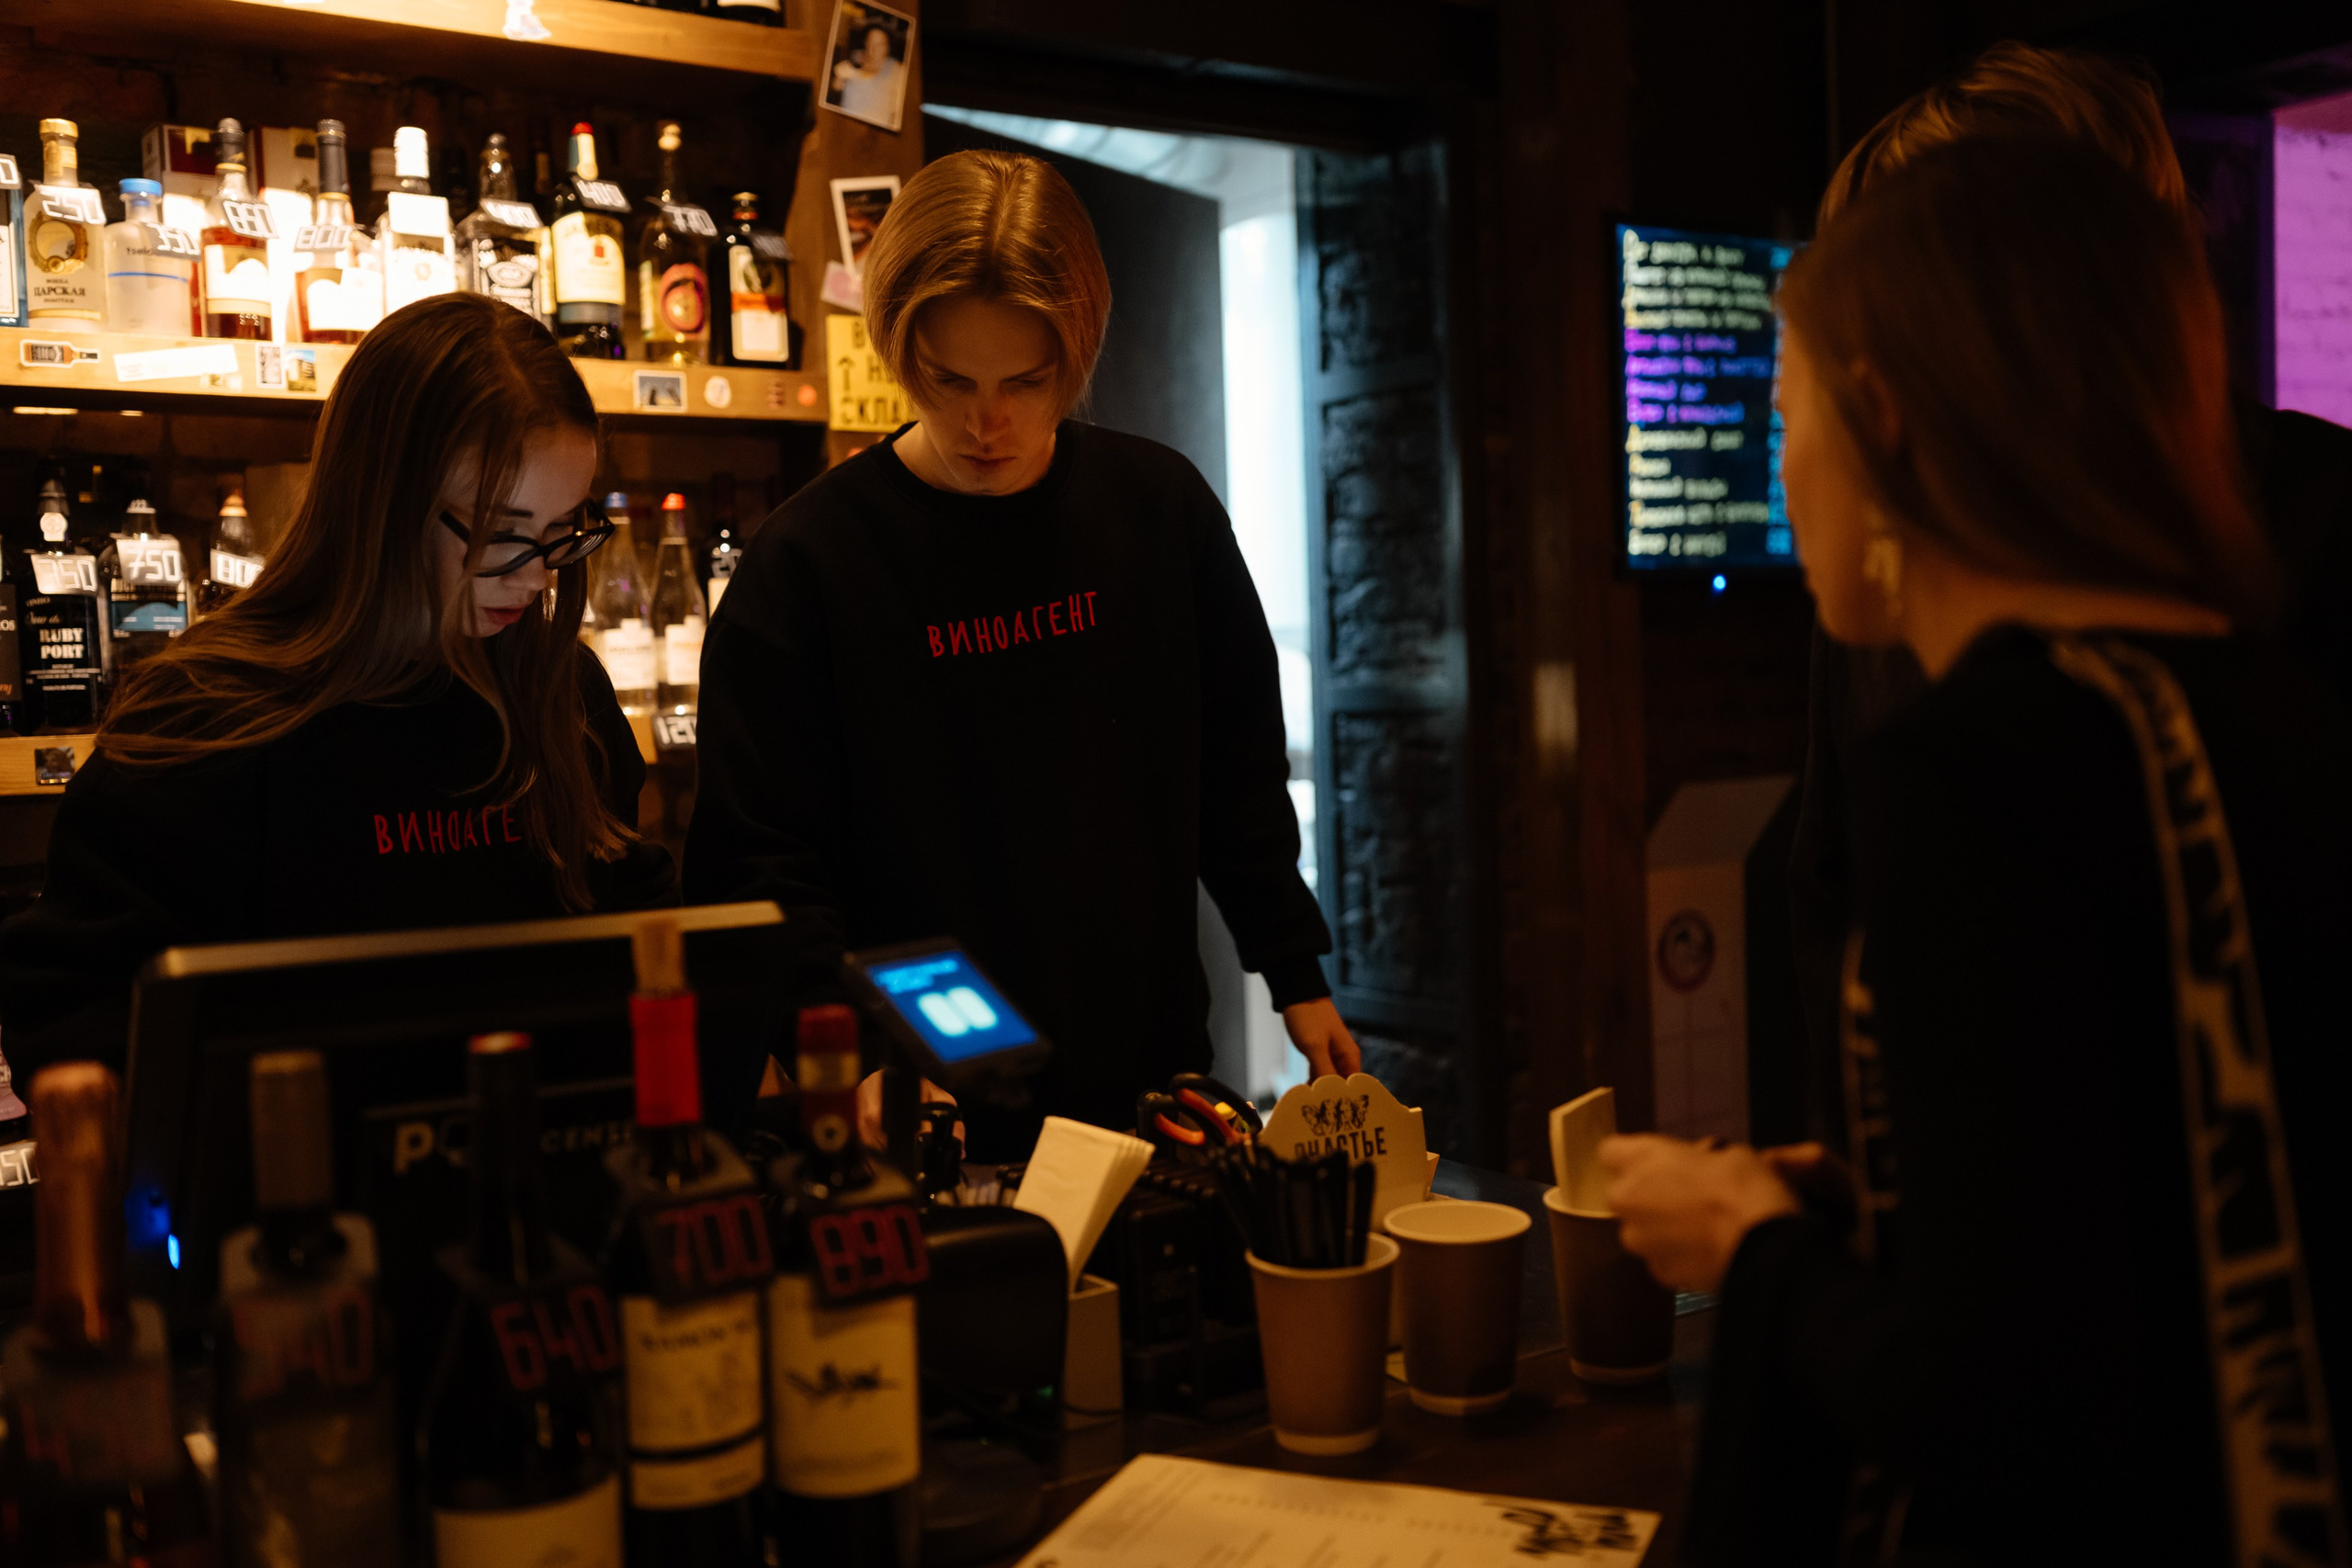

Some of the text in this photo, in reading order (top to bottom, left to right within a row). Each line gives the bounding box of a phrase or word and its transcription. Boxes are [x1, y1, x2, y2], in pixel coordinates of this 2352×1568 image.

[295, 225, 353, 249] 800
[34, 287, 86, 297] ЦАРСКАЯ
[125, 548, 181, 581] 750
[40, 628, 84, 643] RUBY
[926, 591, 1097, 658] ВИНОАГЕНТ
[40, 644, 85, 660] PORT
[373, 804, 522, 854] ВИНОАГЕ
[653, 1193, 775, 1288] 700
[492, 1285, 623, 1391] 640
